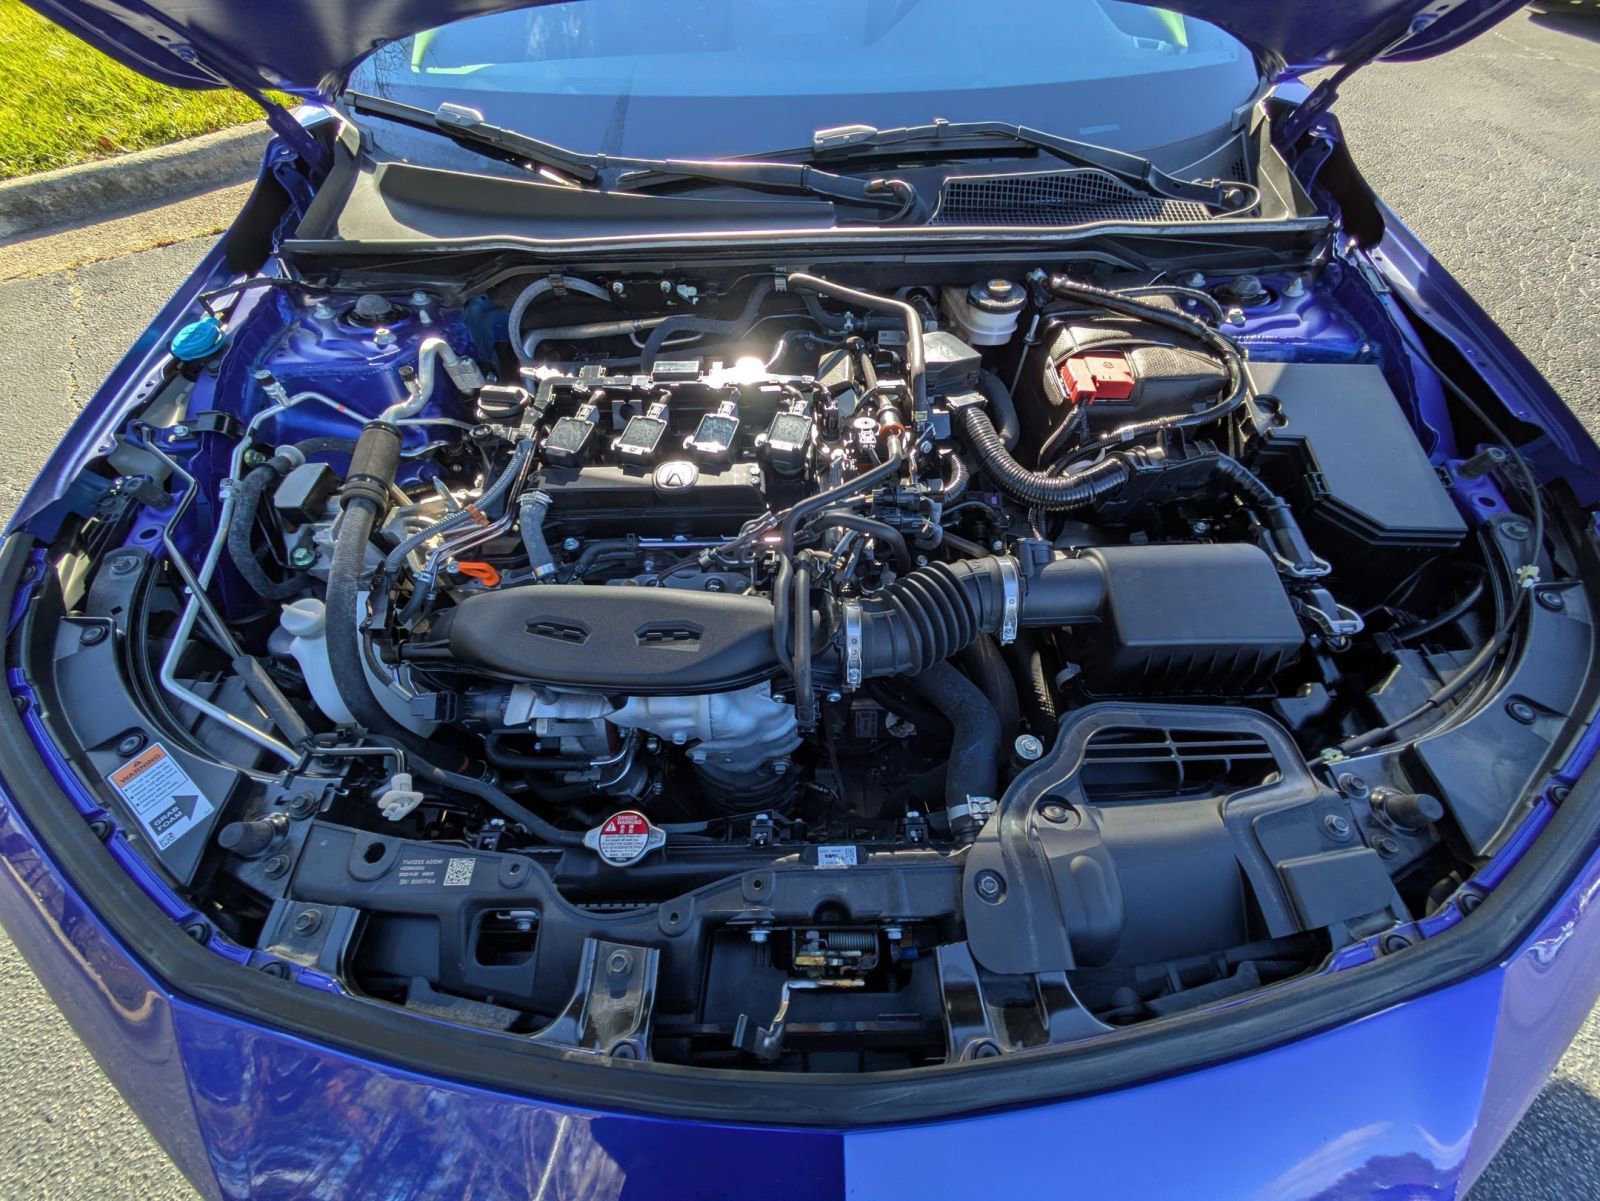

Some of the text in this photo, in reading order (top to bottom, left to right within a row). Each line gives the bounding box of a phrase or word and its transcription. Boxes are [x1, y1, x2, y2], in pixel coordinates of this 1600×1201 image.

[120, 754, 161, 783] WARNING
[154, 806, 179, 826] GRAB
[157, 811, 183, 831] FOAM
